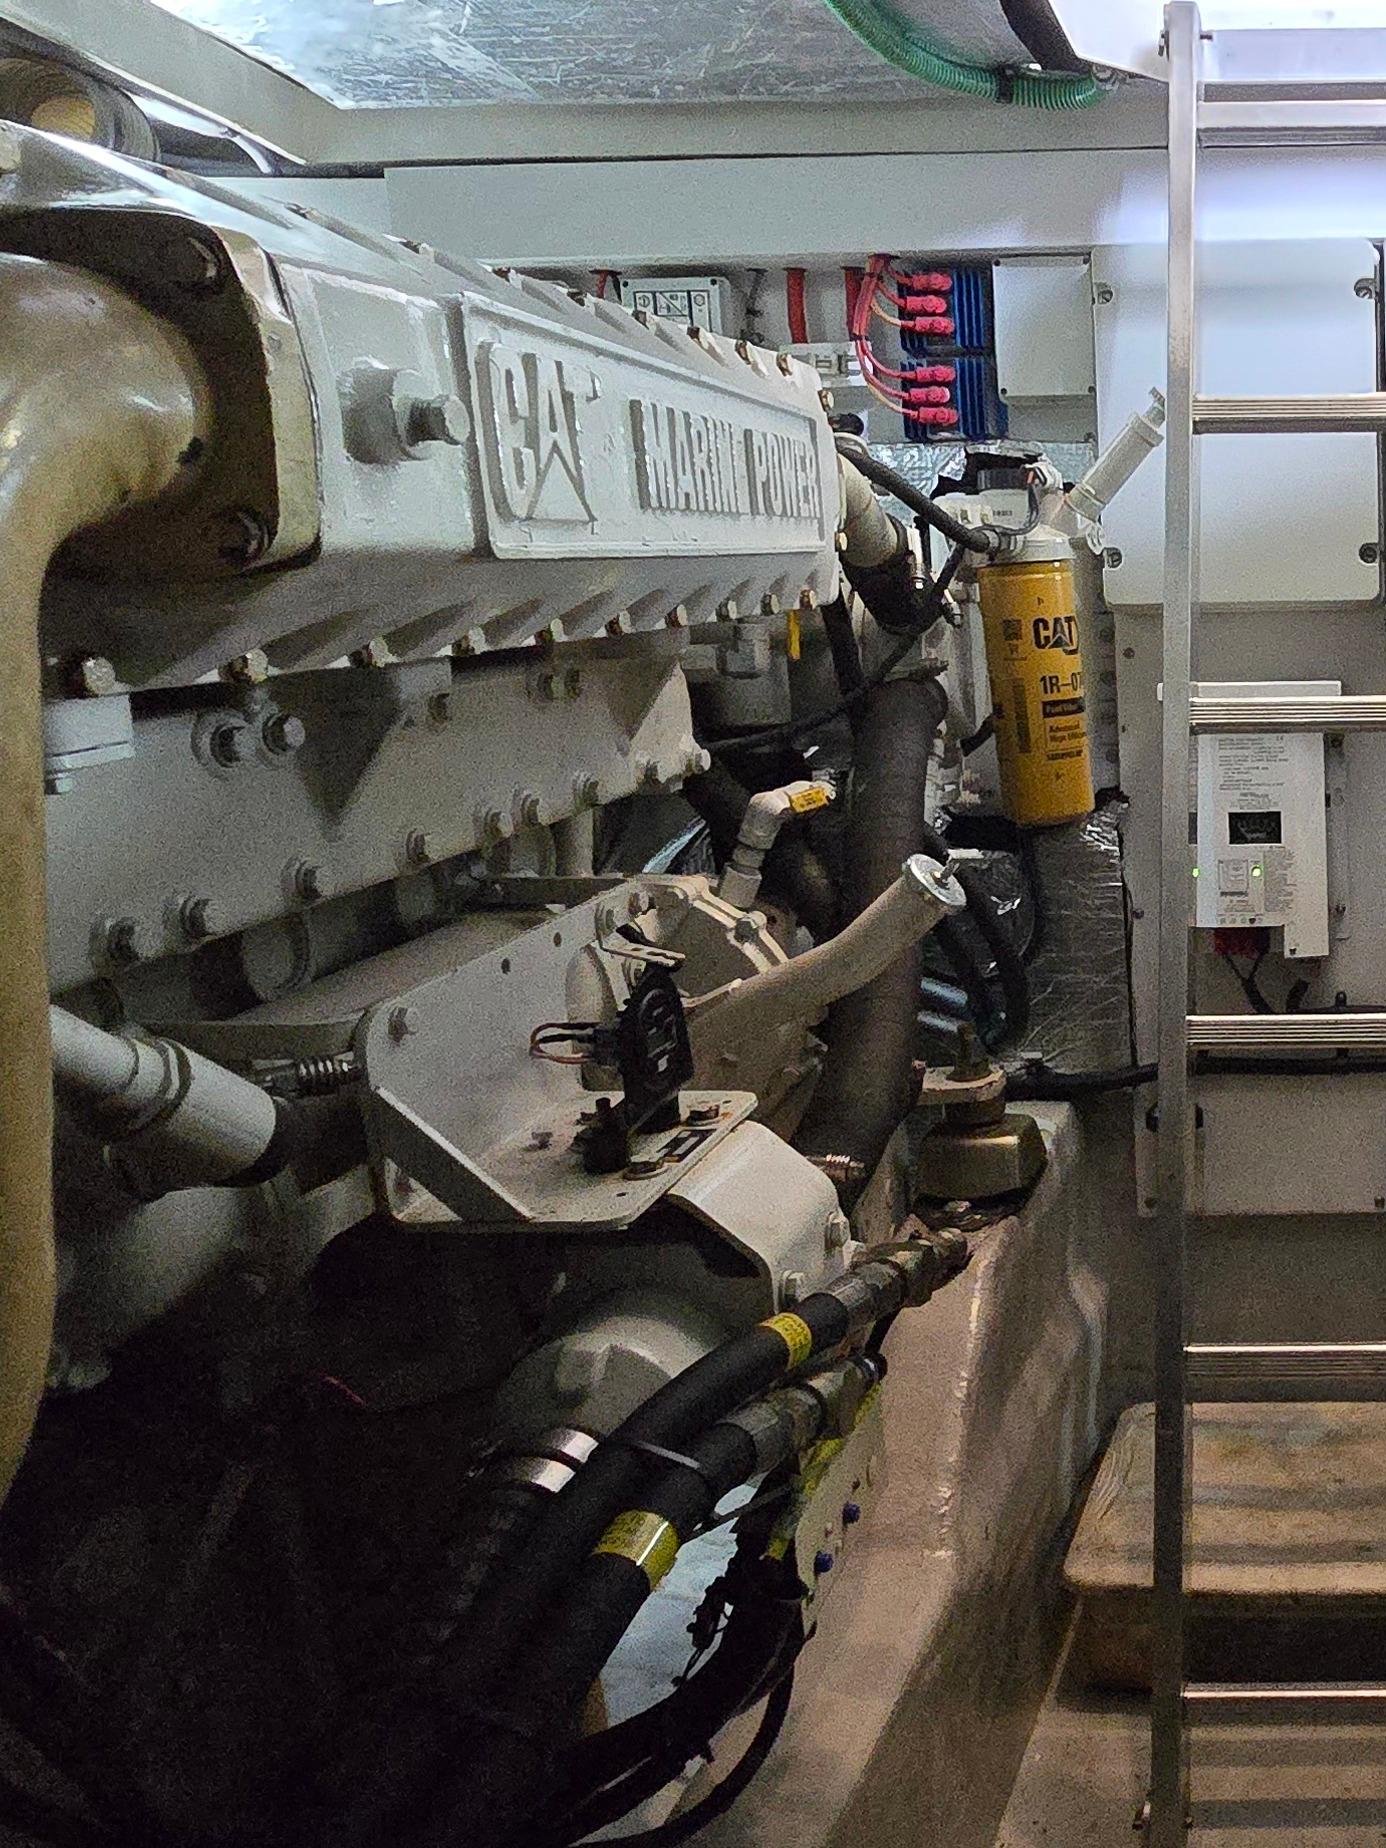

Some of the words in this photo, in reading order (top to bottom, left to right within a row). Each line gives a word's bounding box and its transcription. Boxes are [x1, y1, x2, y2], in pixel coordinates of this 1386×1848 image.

[490, 345, 601, 520] CAT
[642, 400, 739, 512] MARINE
[748, 428, 818, 518] POWER
[1032, 615, 1077, 652] CAT
